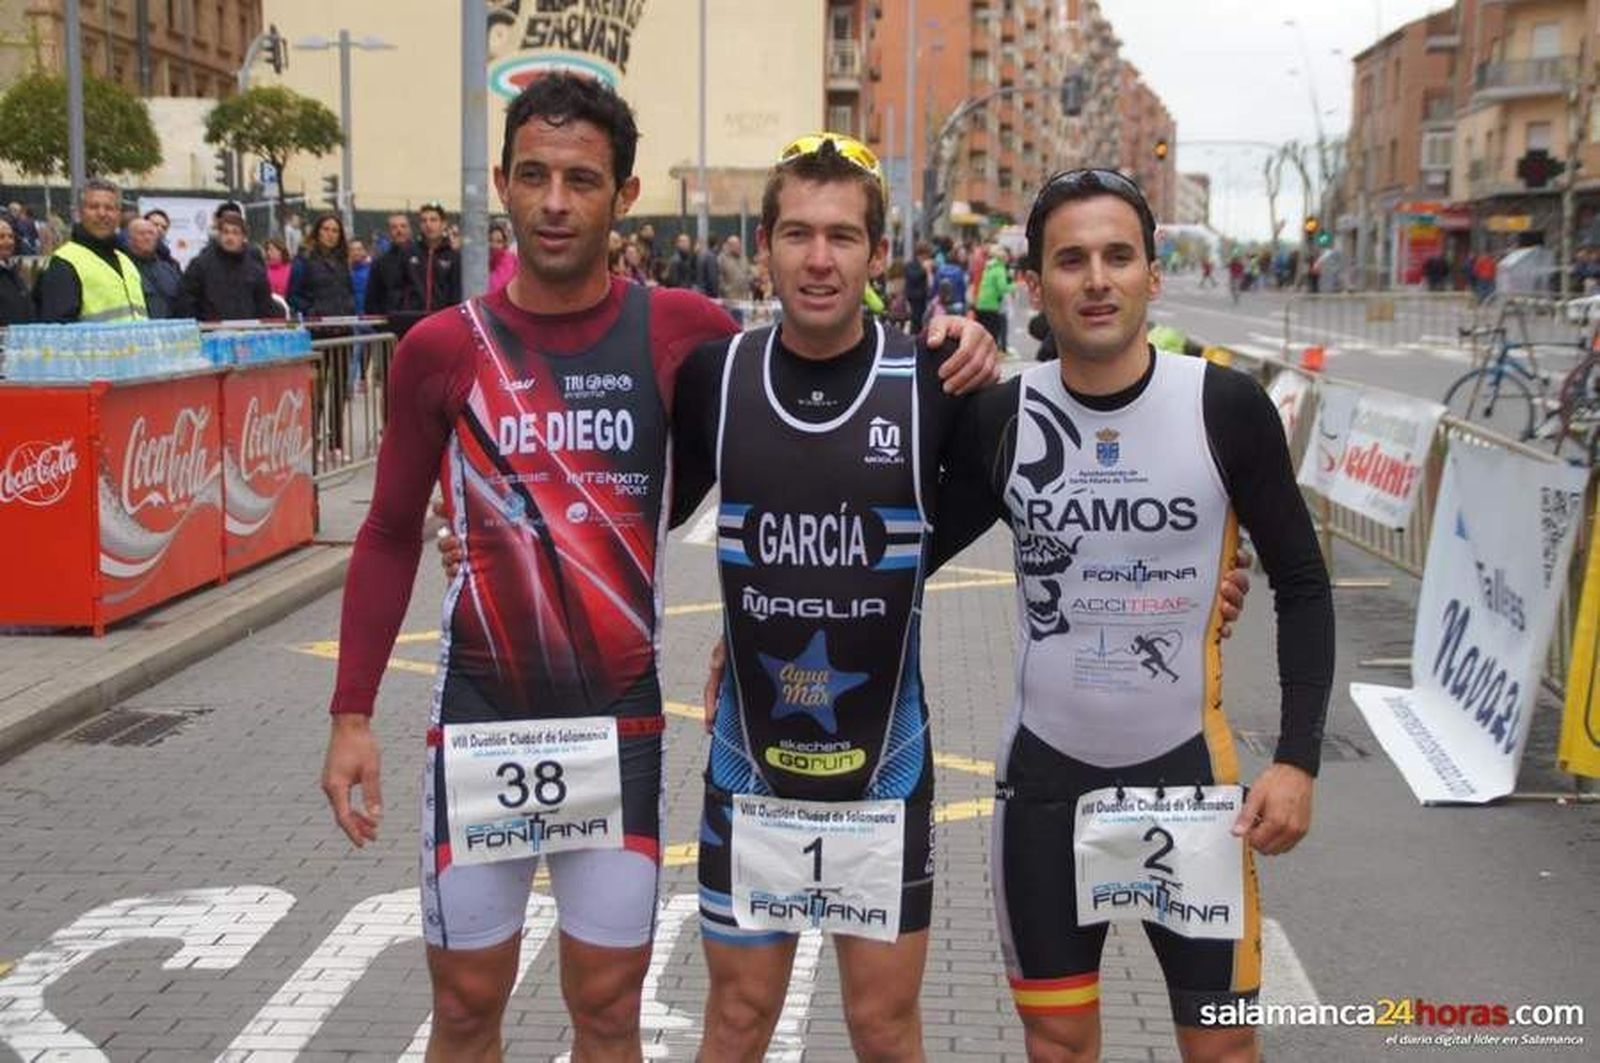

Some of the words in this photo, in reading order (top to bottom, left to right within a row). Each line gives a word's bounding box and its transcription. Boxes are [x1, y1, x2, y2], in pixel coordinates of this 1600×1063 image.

[499, 413, 537, 456] DE
[546, 408, 634, 451] DIEGO
[566, 472, 649, 485] INTENXITY
[615, 484, 648, 497] SPORT
[1027, 497, 1199, 533] RAMOS
[758, 502, 869, 567] GARCÍA
[1082, 561, 1198, 585] FONTANA
[742, 588, 887, 621] MAGLIA
[510, 731, 544, 746] Ciudad
[545, 731, 556, 744] de
[558, 729, 608, 743] Salamanca
[496, 760, 567, 808] 38
[797, 808, 830, 822] Ciudad
[831, 809, 844, 821] de
[845, 810, 896, 824] Salamanca
[1138, 798, 1171, 812] Ciudad
[1172, 799, 1185, 811] de
[1187, 798, 1235, 811] Salamanca
[466, 814, 609, 852] FONTANA
[802, 836, 823, 882] 1
[1143, 826, 1175, 875] 2
[750, 893, 888, 926] FONTANA
[1092, 887, 1230, 924] FONTANA
